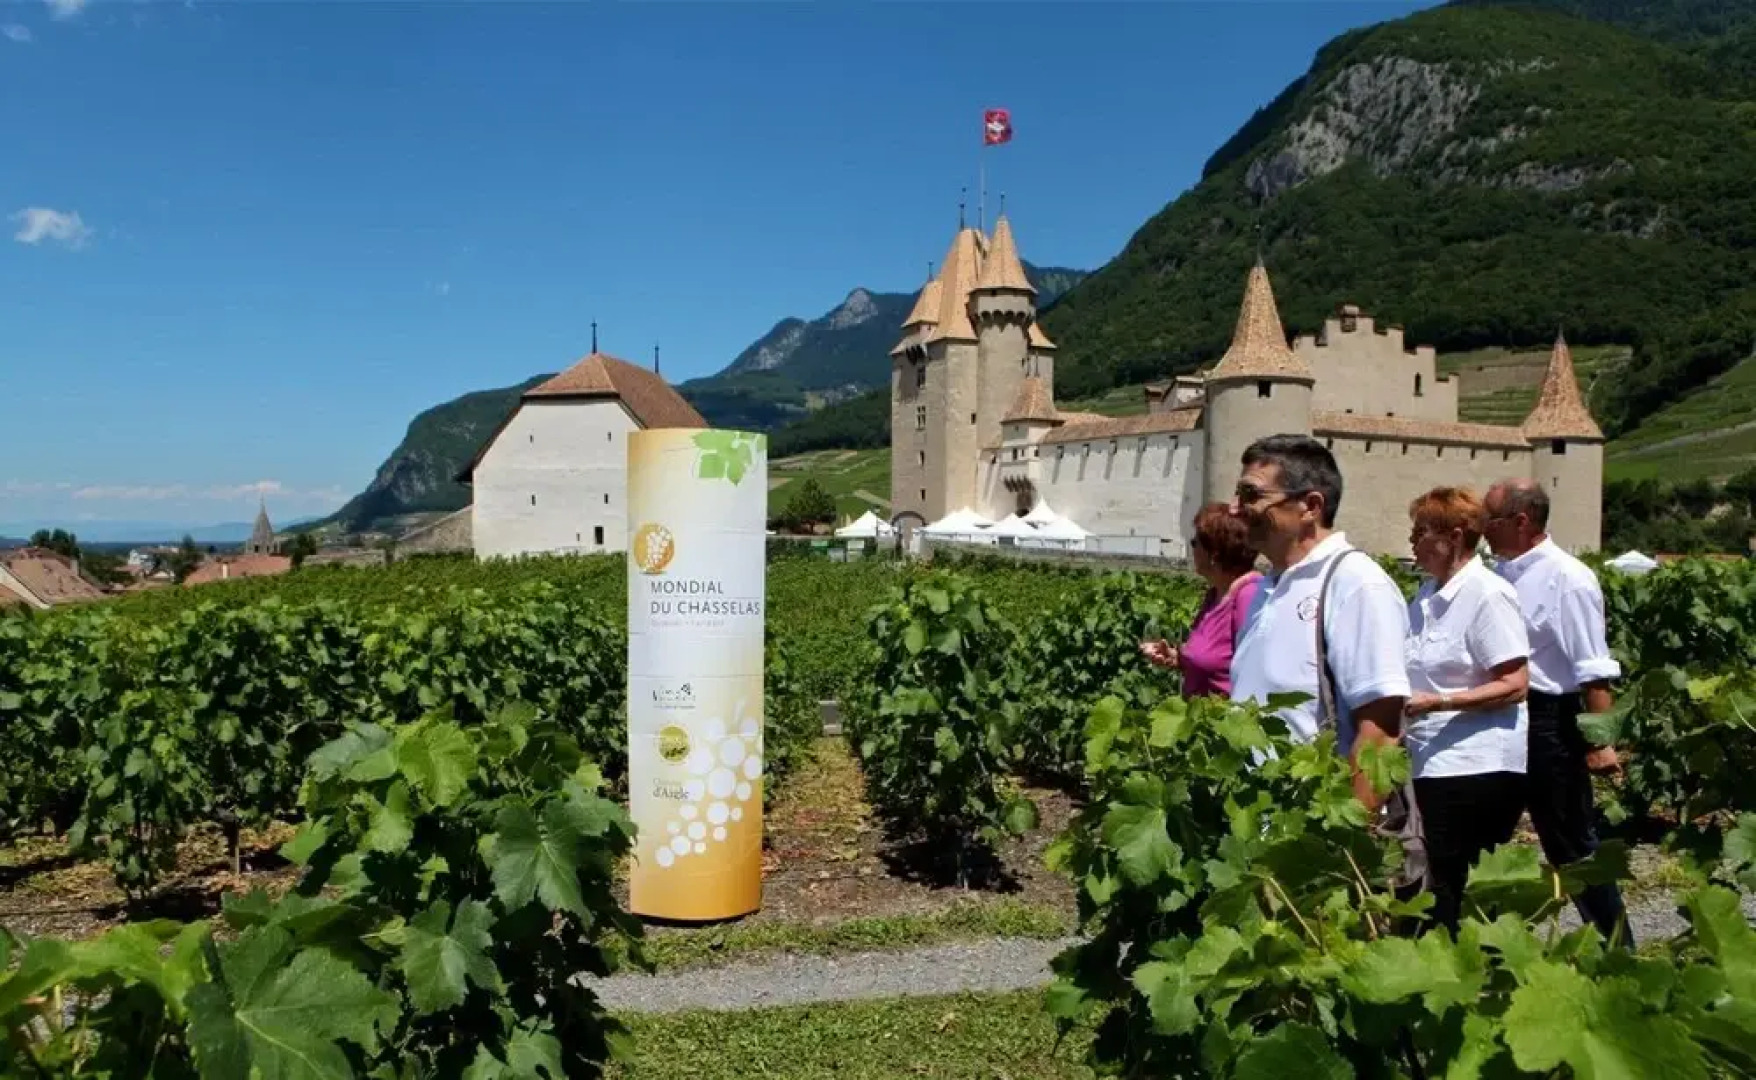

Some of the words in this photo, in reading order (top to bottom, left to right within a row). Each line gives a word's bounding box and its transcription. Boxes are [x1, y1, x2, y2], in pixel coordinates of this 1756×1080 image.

[650, 580, 724, 594] MONDIAL
[650, 601, 671, 615] DU
[677, 601, 760, 616] CHASSELAS
